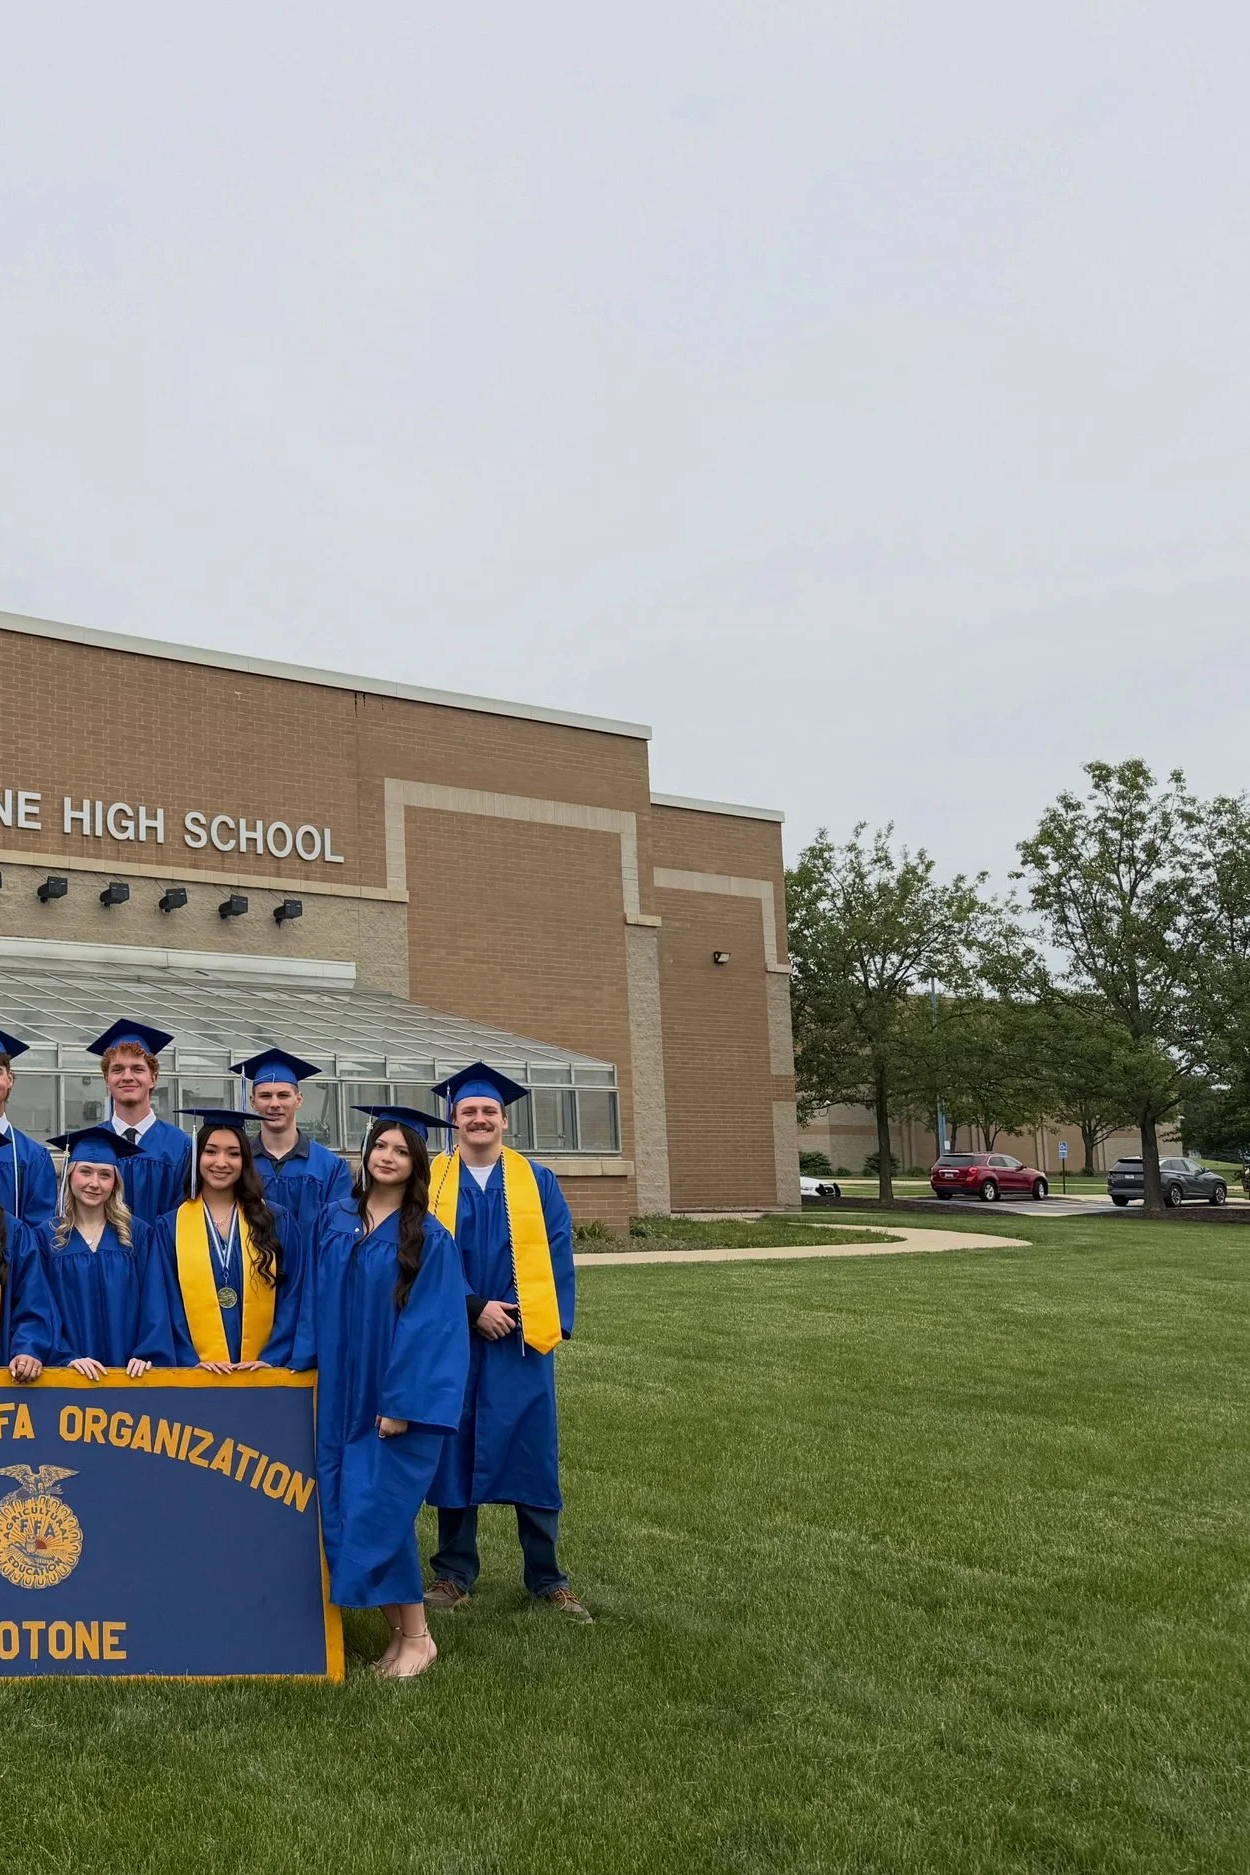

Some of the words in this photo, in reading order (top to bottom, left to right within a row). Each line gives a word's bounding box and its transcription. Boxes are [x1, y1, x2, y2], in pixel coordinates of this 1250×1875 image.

[63, 796, 165, 844] HIGH
[183, 811, 345, 864] SCHOOL
[58, 1405, 316, 1514] ORGANIZATION
[3, 1506, 70, 1542] AGRICULTURAL
[19, 1519, 56, 1538] FFA
[7, 1555, 64, 1576] EDUCATION
